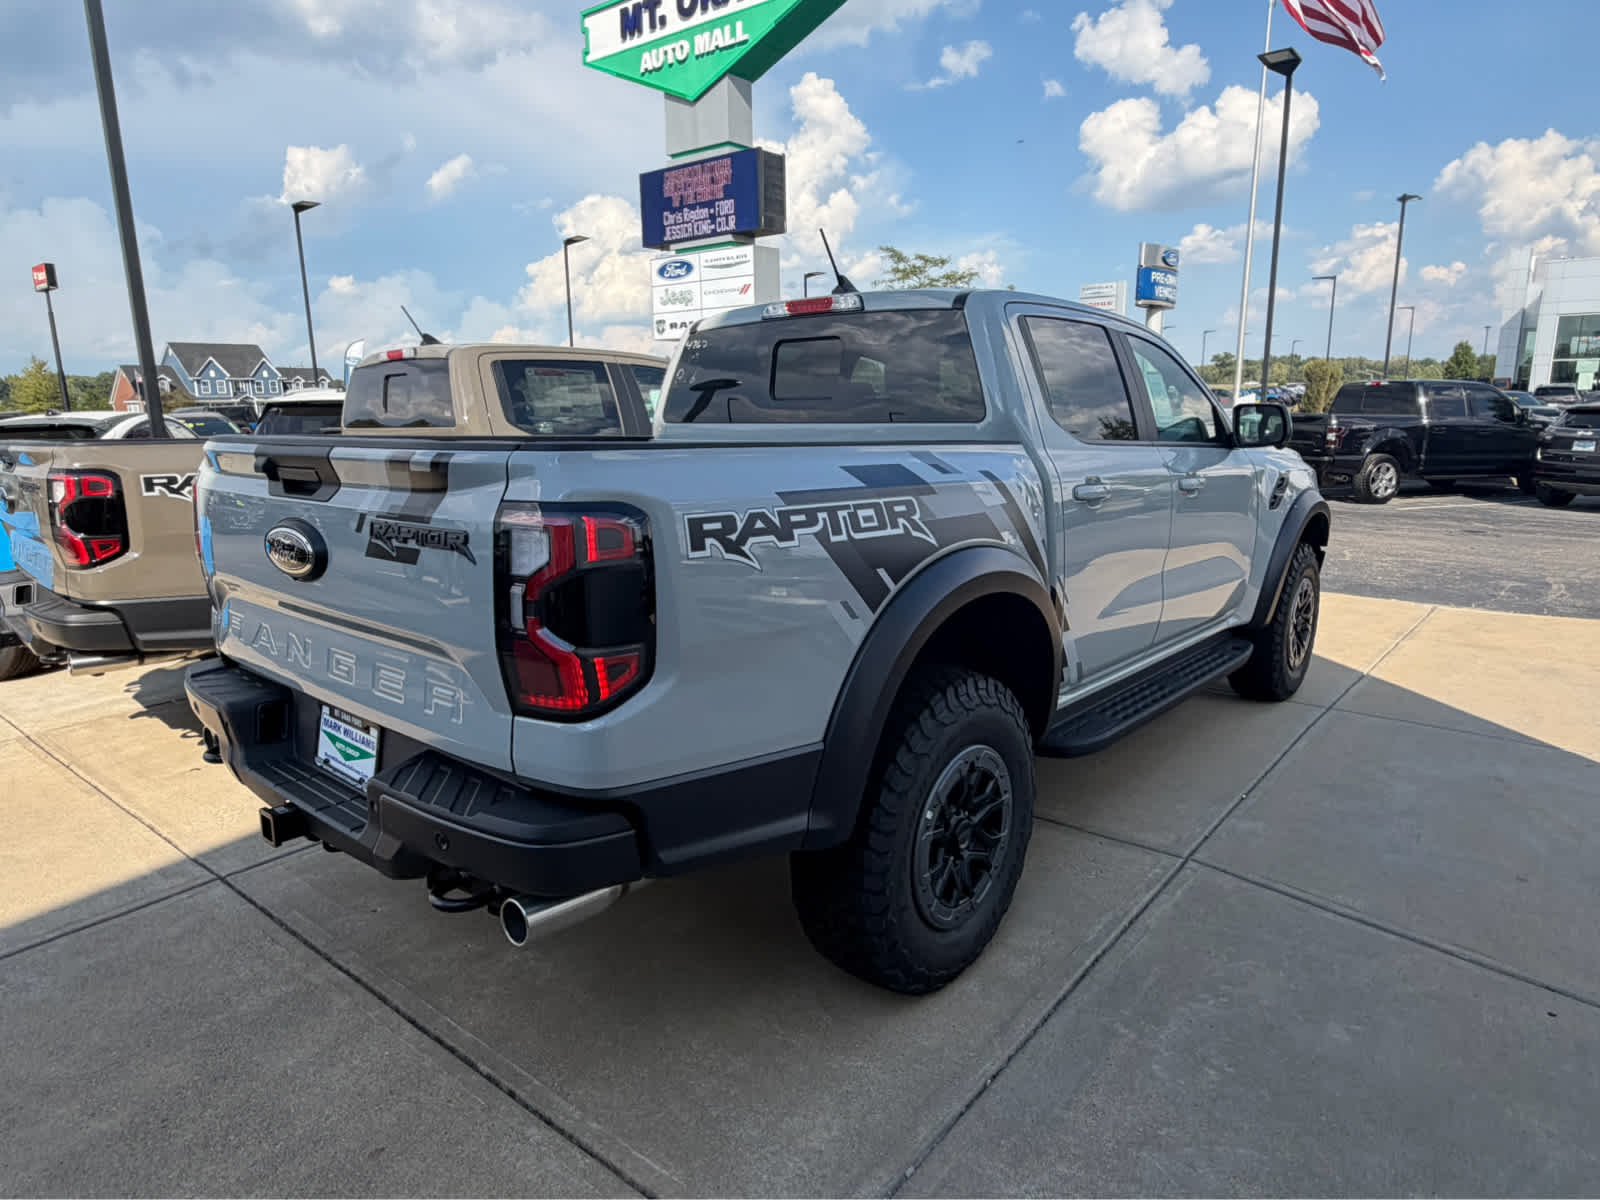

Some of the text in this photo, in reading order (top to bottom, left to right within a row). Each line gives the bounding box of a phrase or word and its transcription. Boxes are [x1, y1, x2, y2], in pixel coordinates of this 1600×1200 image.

[619, 0, 667, 43] MT.
[640, 20, 749, 74] AUTO MALL
[663, 210, 683, 227] Chris
[715, 199, 735, 217] FORD
[663, 223, 693, 241] JESSICA
[669, 320, 693, 330] RA
[369, 519, 478, 566] RAPTOR
[682, 496, 939, 573] RAPTOR
[322, 716, 343, 736] MARK
